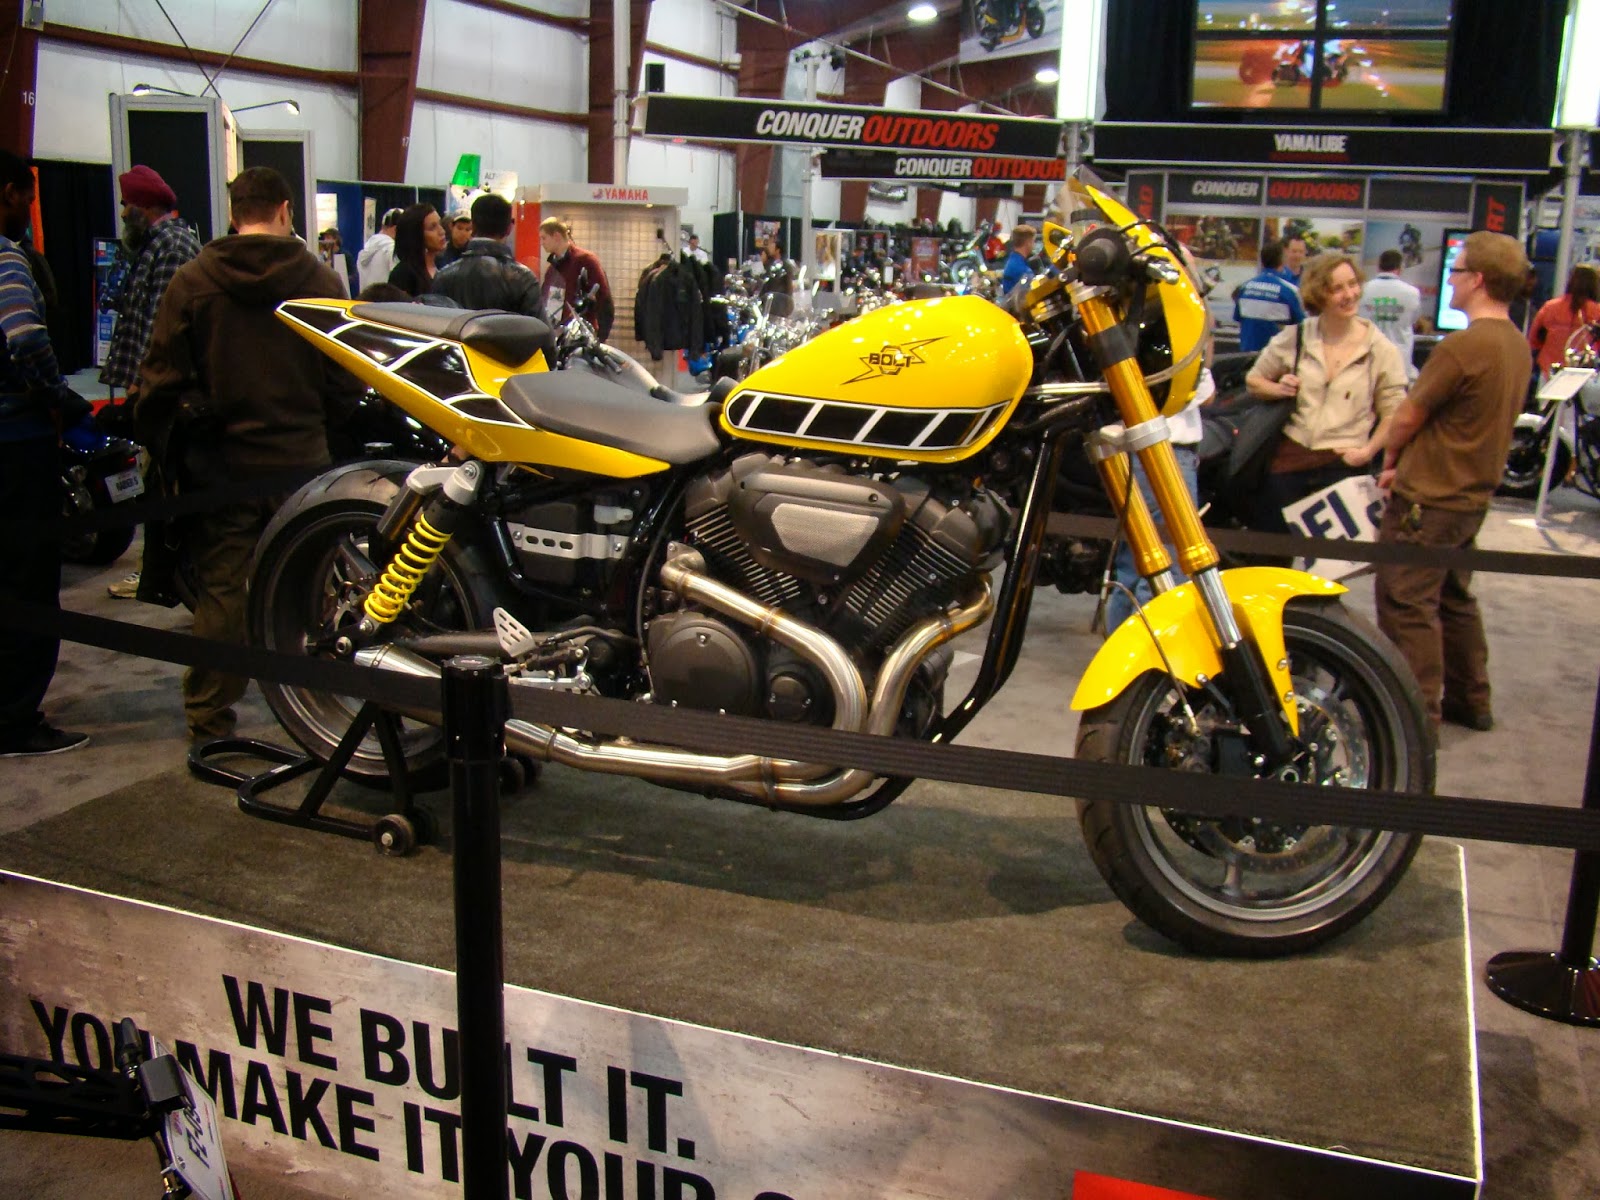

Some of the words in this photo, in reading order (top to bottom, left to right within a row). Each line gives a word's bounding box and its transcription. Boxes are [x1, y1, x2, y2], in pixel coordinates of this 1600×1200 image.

[22, 91, 35, 106] 16
[756, 109, 865, 140] CONQUER
[863, 114, 999, 149] OUTDOORS
[1273, 134, 1349, 153] YAMALUBE
[895, 157, 973, 176] CONQUER
[605, 188, 648, 200] YAMAHA
[1192, 181, 1260, 197] CONQUER
[1269, 181, 1361, 201] OUTDOORS
[868, 352, 912, 368] BOLT
[222, 974, 338, 1071] WE
[360, 1008, 577, 1128] BULT
[608, 1065, 695, 1160] IT.
[175, 1039, 380, 1162] MAKE
[403, 1101, 462, 1183] IT
